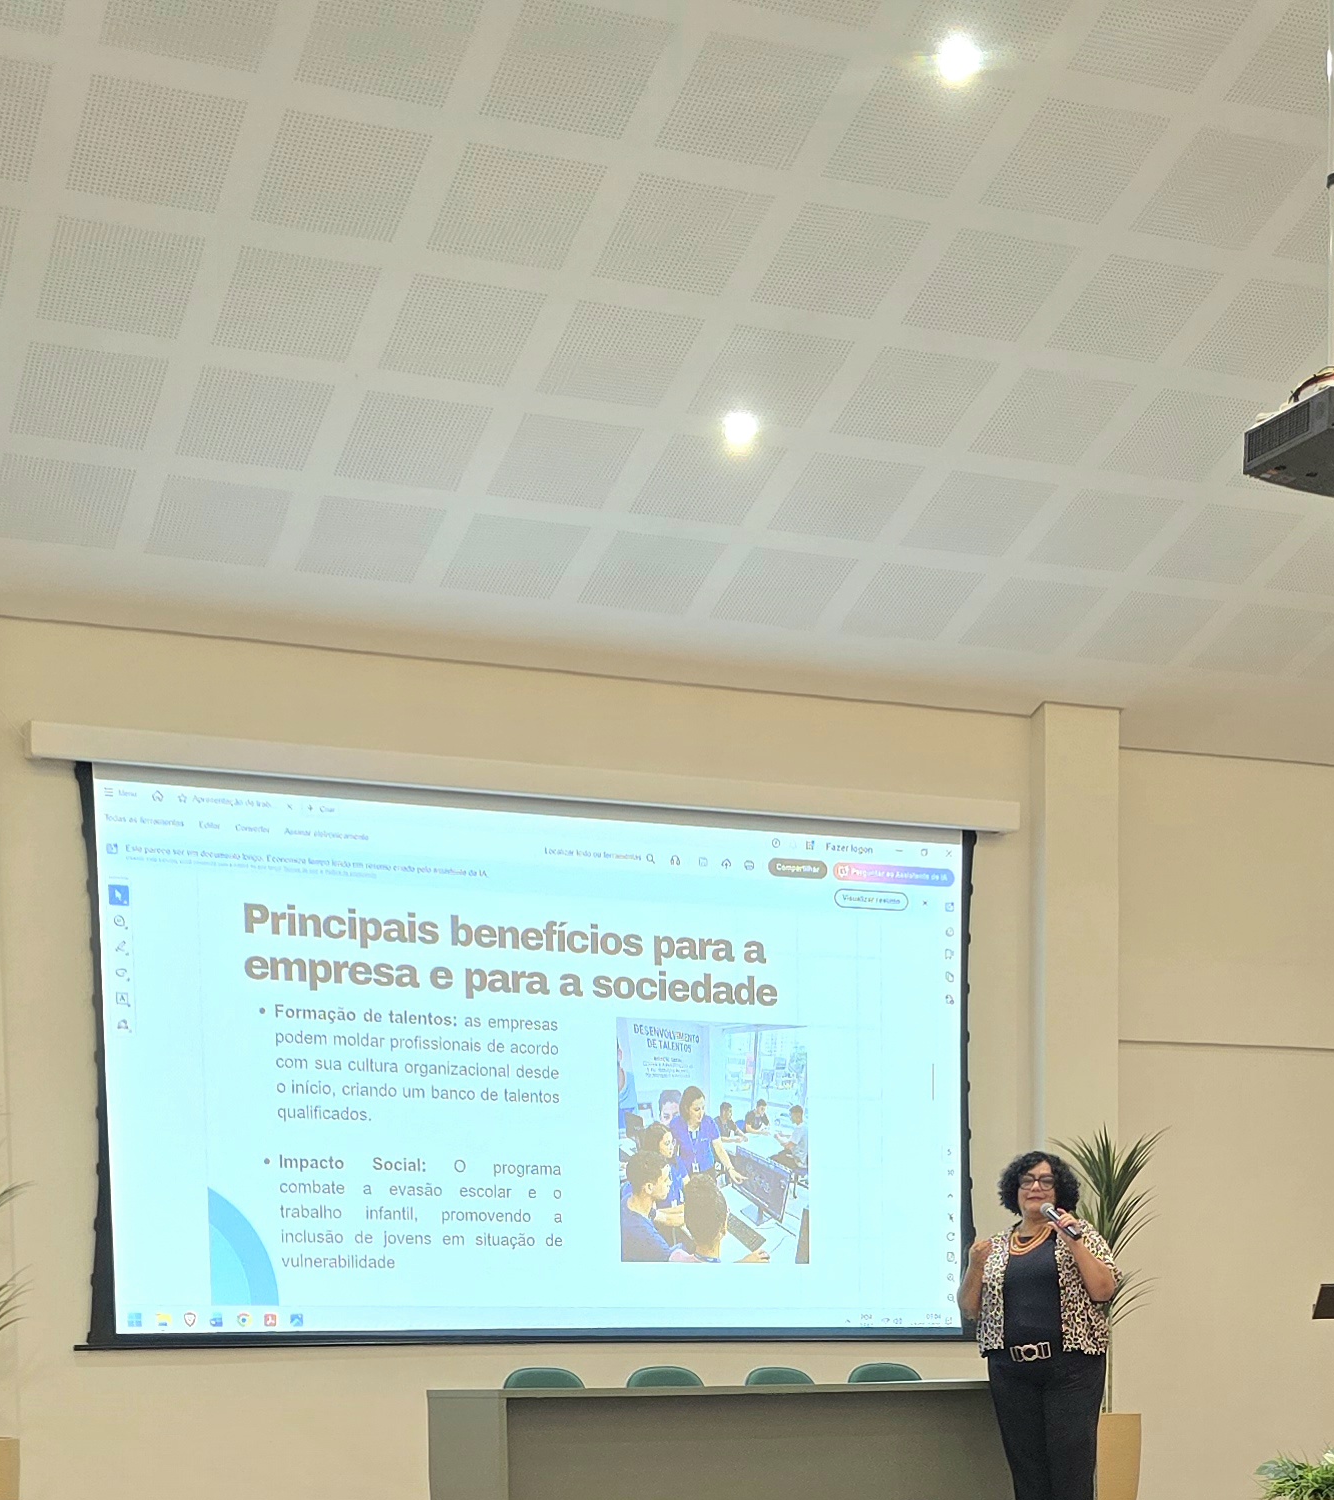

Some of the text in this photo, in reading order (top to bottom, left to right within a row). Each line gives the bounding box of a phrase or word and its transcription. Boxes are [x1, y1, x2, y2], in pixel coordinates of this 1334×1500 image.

[825, 842, 874, 856] Fazer logon
[775, 862, 820, 875] Compartilhar
[243, 902, 767, 966] Principais benefícios para a
[243, 955, 779, 1007] empresa e para a sociedade
[274, 1003, 559, 1033] Formação de talentos: as empresas
[275, 1030, 559, 1056] podem moldar profissionais de acordo
[646, 1038, 692, 1054] DE TALENTOS
[275, 1057, 560, 1080] com sua cultura organizacional desde
[276, 1080, 560, 1104] o início, criando um banco de talentos
[277, 1105, 372, 1123] qualificados.
[278, 1154, 562, 1178] Impacto Social: O programa
[279, 1180, 562, 1200] combate a evasão escolar e o
[279, 1204, 563, 1225] trabalho infantil, promovendo a
[281, 1229, 563, 1250] inclusão de jovens em situação de
[281, 1253, 396, 1270] vulnerabilidade
